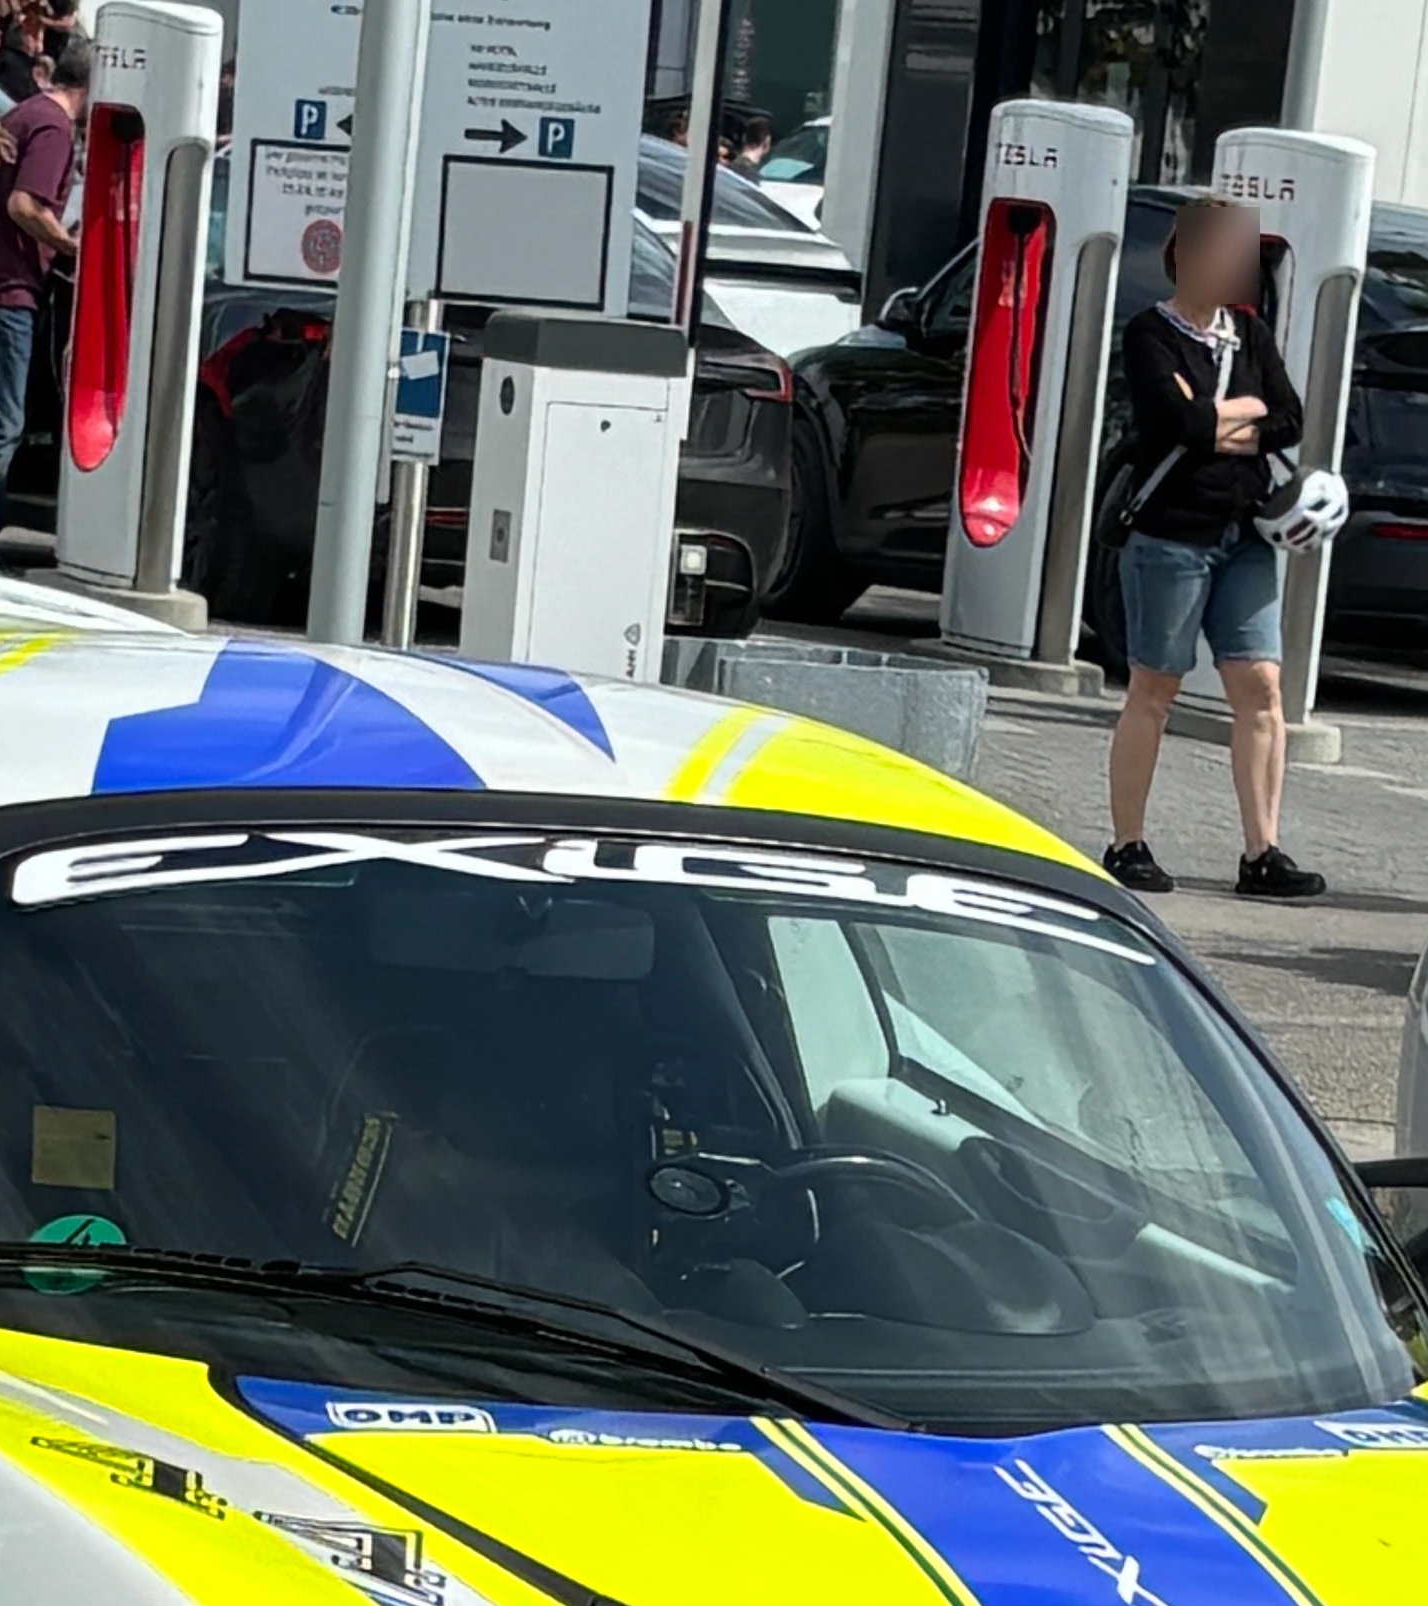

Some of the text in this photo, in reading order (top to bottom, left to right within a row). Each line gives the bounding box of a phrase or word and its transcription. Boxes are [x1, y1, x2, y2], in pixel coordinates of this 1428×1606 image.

[301, 103, 319, 135] P
[547, 121, 565, 154] P
[1220, 173, 1295, 201] TESLA
[11, 831, 1157, 966] EXIGE
[344, 1408, 477, 1426] OMP
